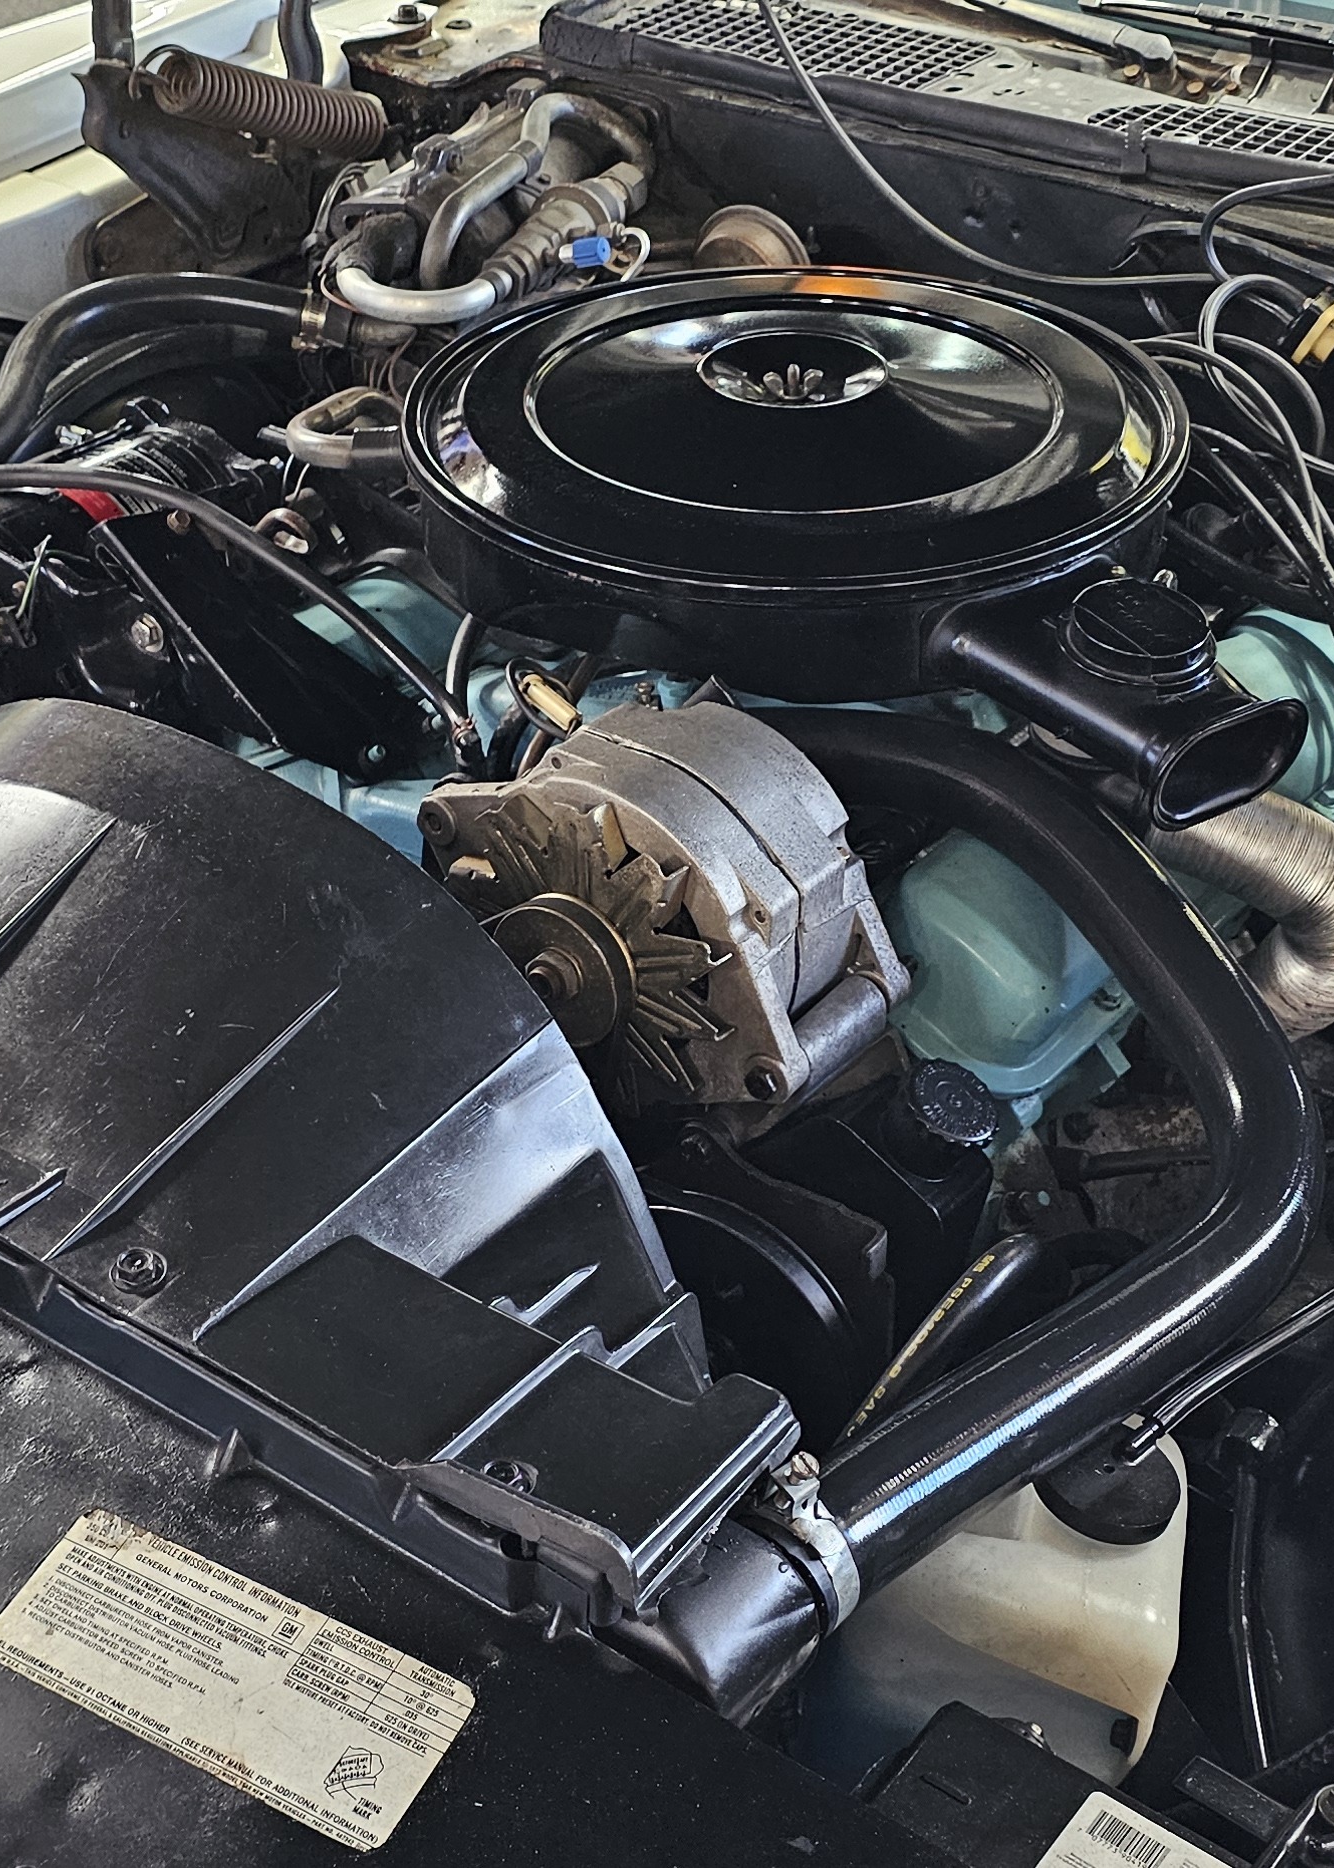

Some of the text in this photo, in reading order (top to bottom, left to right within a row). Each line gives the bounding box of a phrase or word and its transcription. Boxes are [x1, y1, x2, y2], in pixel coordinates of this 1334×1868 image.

[135, 1553, 268, 1621] GENERAL MOTORS CORPORATION
[147, 1535, 179, 1557] VEHICLE
[177, 1551, 214, 1574] EMISSION
[212, 1568, 247, 1591] CONTROL
[248, 1586, 300, 1617] INFORMATION
[54, 1578, 94, 1600] DISCONNECT
[93, 1597, 134, 1620] CARBURETOR
[133, 1618, 152, 1629] HOSE
[151, 1626, 170, 1639] FROM
[170, 1636, 192, 1650] VAPOR
[57, 1562, 221, 1649] SET PARKING BRAKE AND BLOCK DRIVE WHEELS.
[65, 1552, 266, 1657] OPEN AND AIR CONDITIONING PLUG DISCONNECTED VACUUM FITTINGS.
[71, 1546, 88, 1558] MAKE
[87, 1554, 126, 1577] ADJUSTMENTS
[125, 1573, 142, 1584] WITH
[140, 1580, 162, 1595] ENGINE
[161, 1591, 171, 1599] AT
[169, 1595, 193, 1610] NORMAL
[193, 1606, 226, 1626] OPERATING
[267, 1643, 288, 1658] CHOKE
[28, 1611, 65, 1632] RECONNECT
[64, 1629, 105, 1653] DISTRIBUTOR
[105, 1650, 120, 1660] AND
[119, 1657, 150, 1676] CANISTER
[34, 1603, 187, 1684] ADJUST CARBURETOR SPEED SCREW SPECIFIED
[39, 1596, 150, 1655] SET DWELL AND TIMING SPECIFIED
[49, 1585, 239, 1684] DISCONNECT DISTRIBUTOR VACUUM PLUG HOSE LEADING
[281, 1621, 298, 1635] GM
[335, 1626, 388, 1654] CCS EXHAUST
[305, 1648, 328, 1663] TIMING
[313, 1637, 334, 1651] DWELL
[321, 1628, 394, 1668] EMISSION CONTROL
[291, 1668, 350, 1701] CARB. SCREW (RPM)
[299, 1658, 349, 1685] SPARK PLUG GAP
[409, 1670, 455, 1696] TRANSMISSION
[418, 1665, 455, 1687] AUTOMATIC
[282, 1677, 427, 1754] IDLE MIXTURE PRESET NOT REMOVE CAPS.
[384, 1714, 429, 1740] 625 (IN DRIVE)
[404, 1710, 418, 1720] .035
[415, 1702, 439, 1716] @ 625
[6, 1645, 63, 1678] REQUIREMENTS
[69, 1677, 86, 1689] USE
[95, 1691, 127, 1711] OCTANE
[127, 1707, 140, 1718] OR
[139, 1714, 170, 1734] HIGHER
[180, 1736, 200, 1750] (SEE
[199, 1745, 227, 1763] SERVICE
[226, 1758, 254, 1778] MANUAL
[254, 1774, 272, 1787] FOR
[272, 1784, 318, 1812] ADDITIONAL
[320, 1809, 378, 1843] INFORMATION)
[352, 1805, 371, 1819] MARK
[357, 1797, 382, 1814] TIMING
